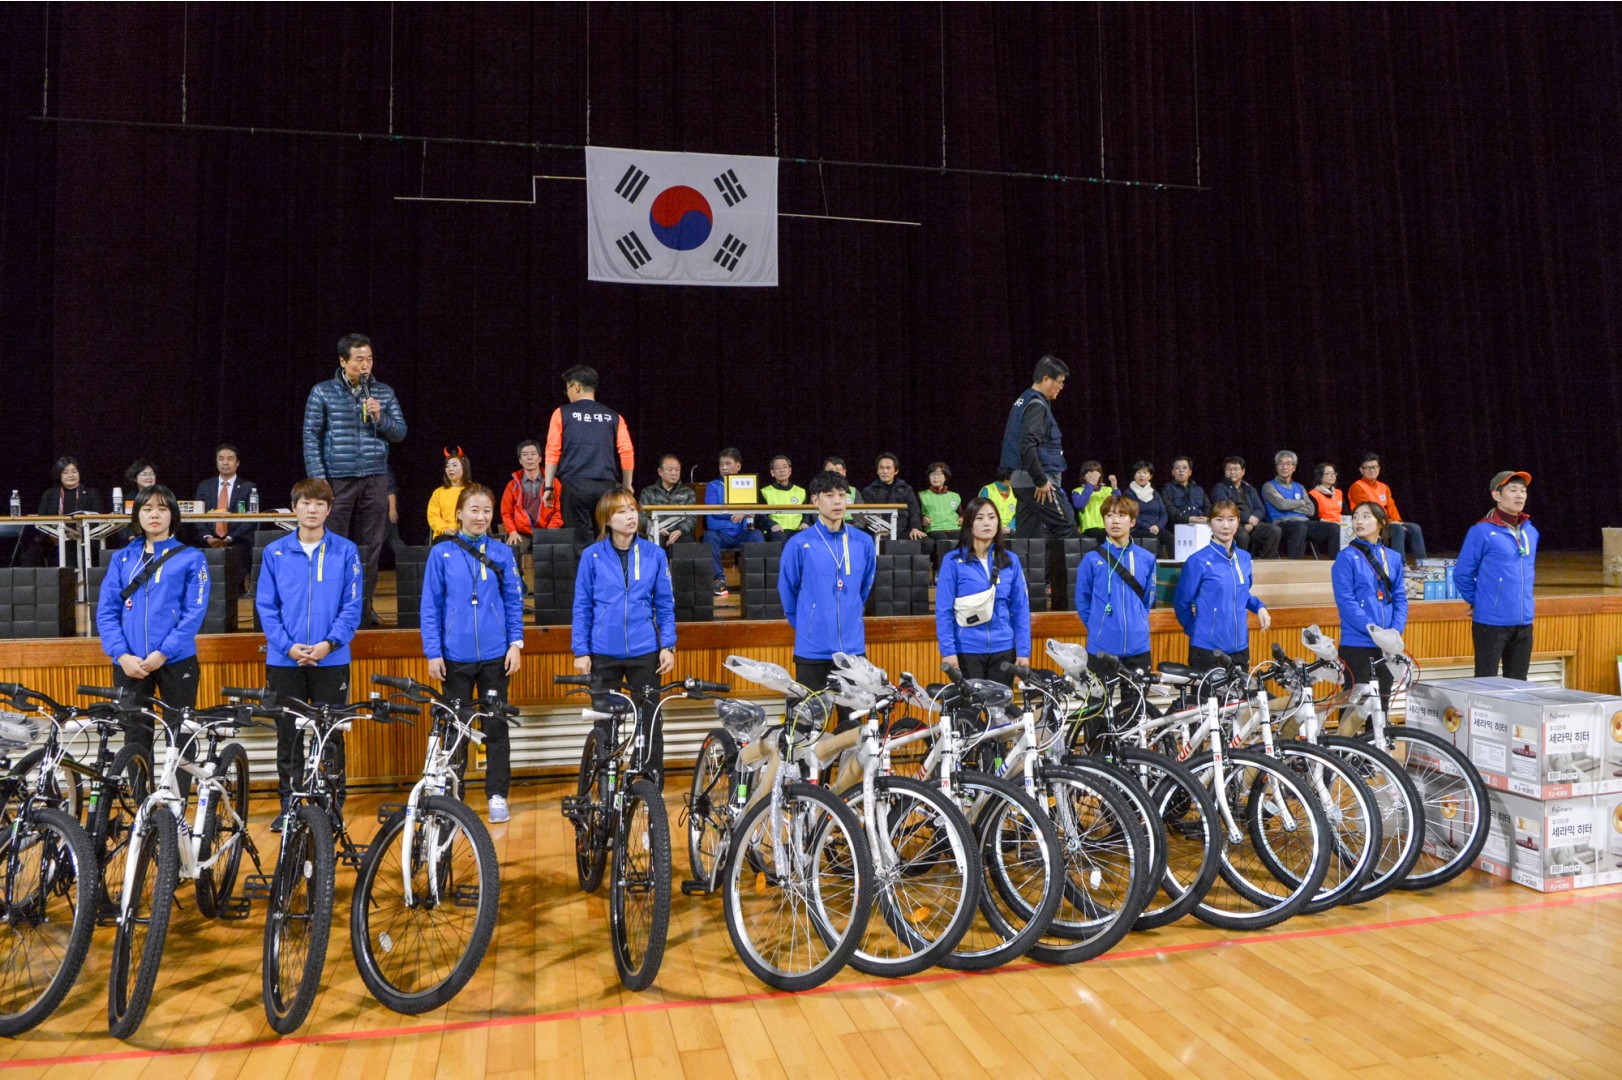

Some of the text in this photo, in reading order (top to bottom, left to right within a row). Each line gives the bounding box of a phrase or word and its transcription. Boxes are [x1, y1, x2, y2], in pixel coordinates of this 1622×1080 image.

[572, 411, 612, 422] 해운대구
[1473, 717, 1508, 734] 세라믹 히터
[1549, 730, 1590, 743] 세라믹 히터
[1551, 823, 1592, 837] 세라믹 히터
